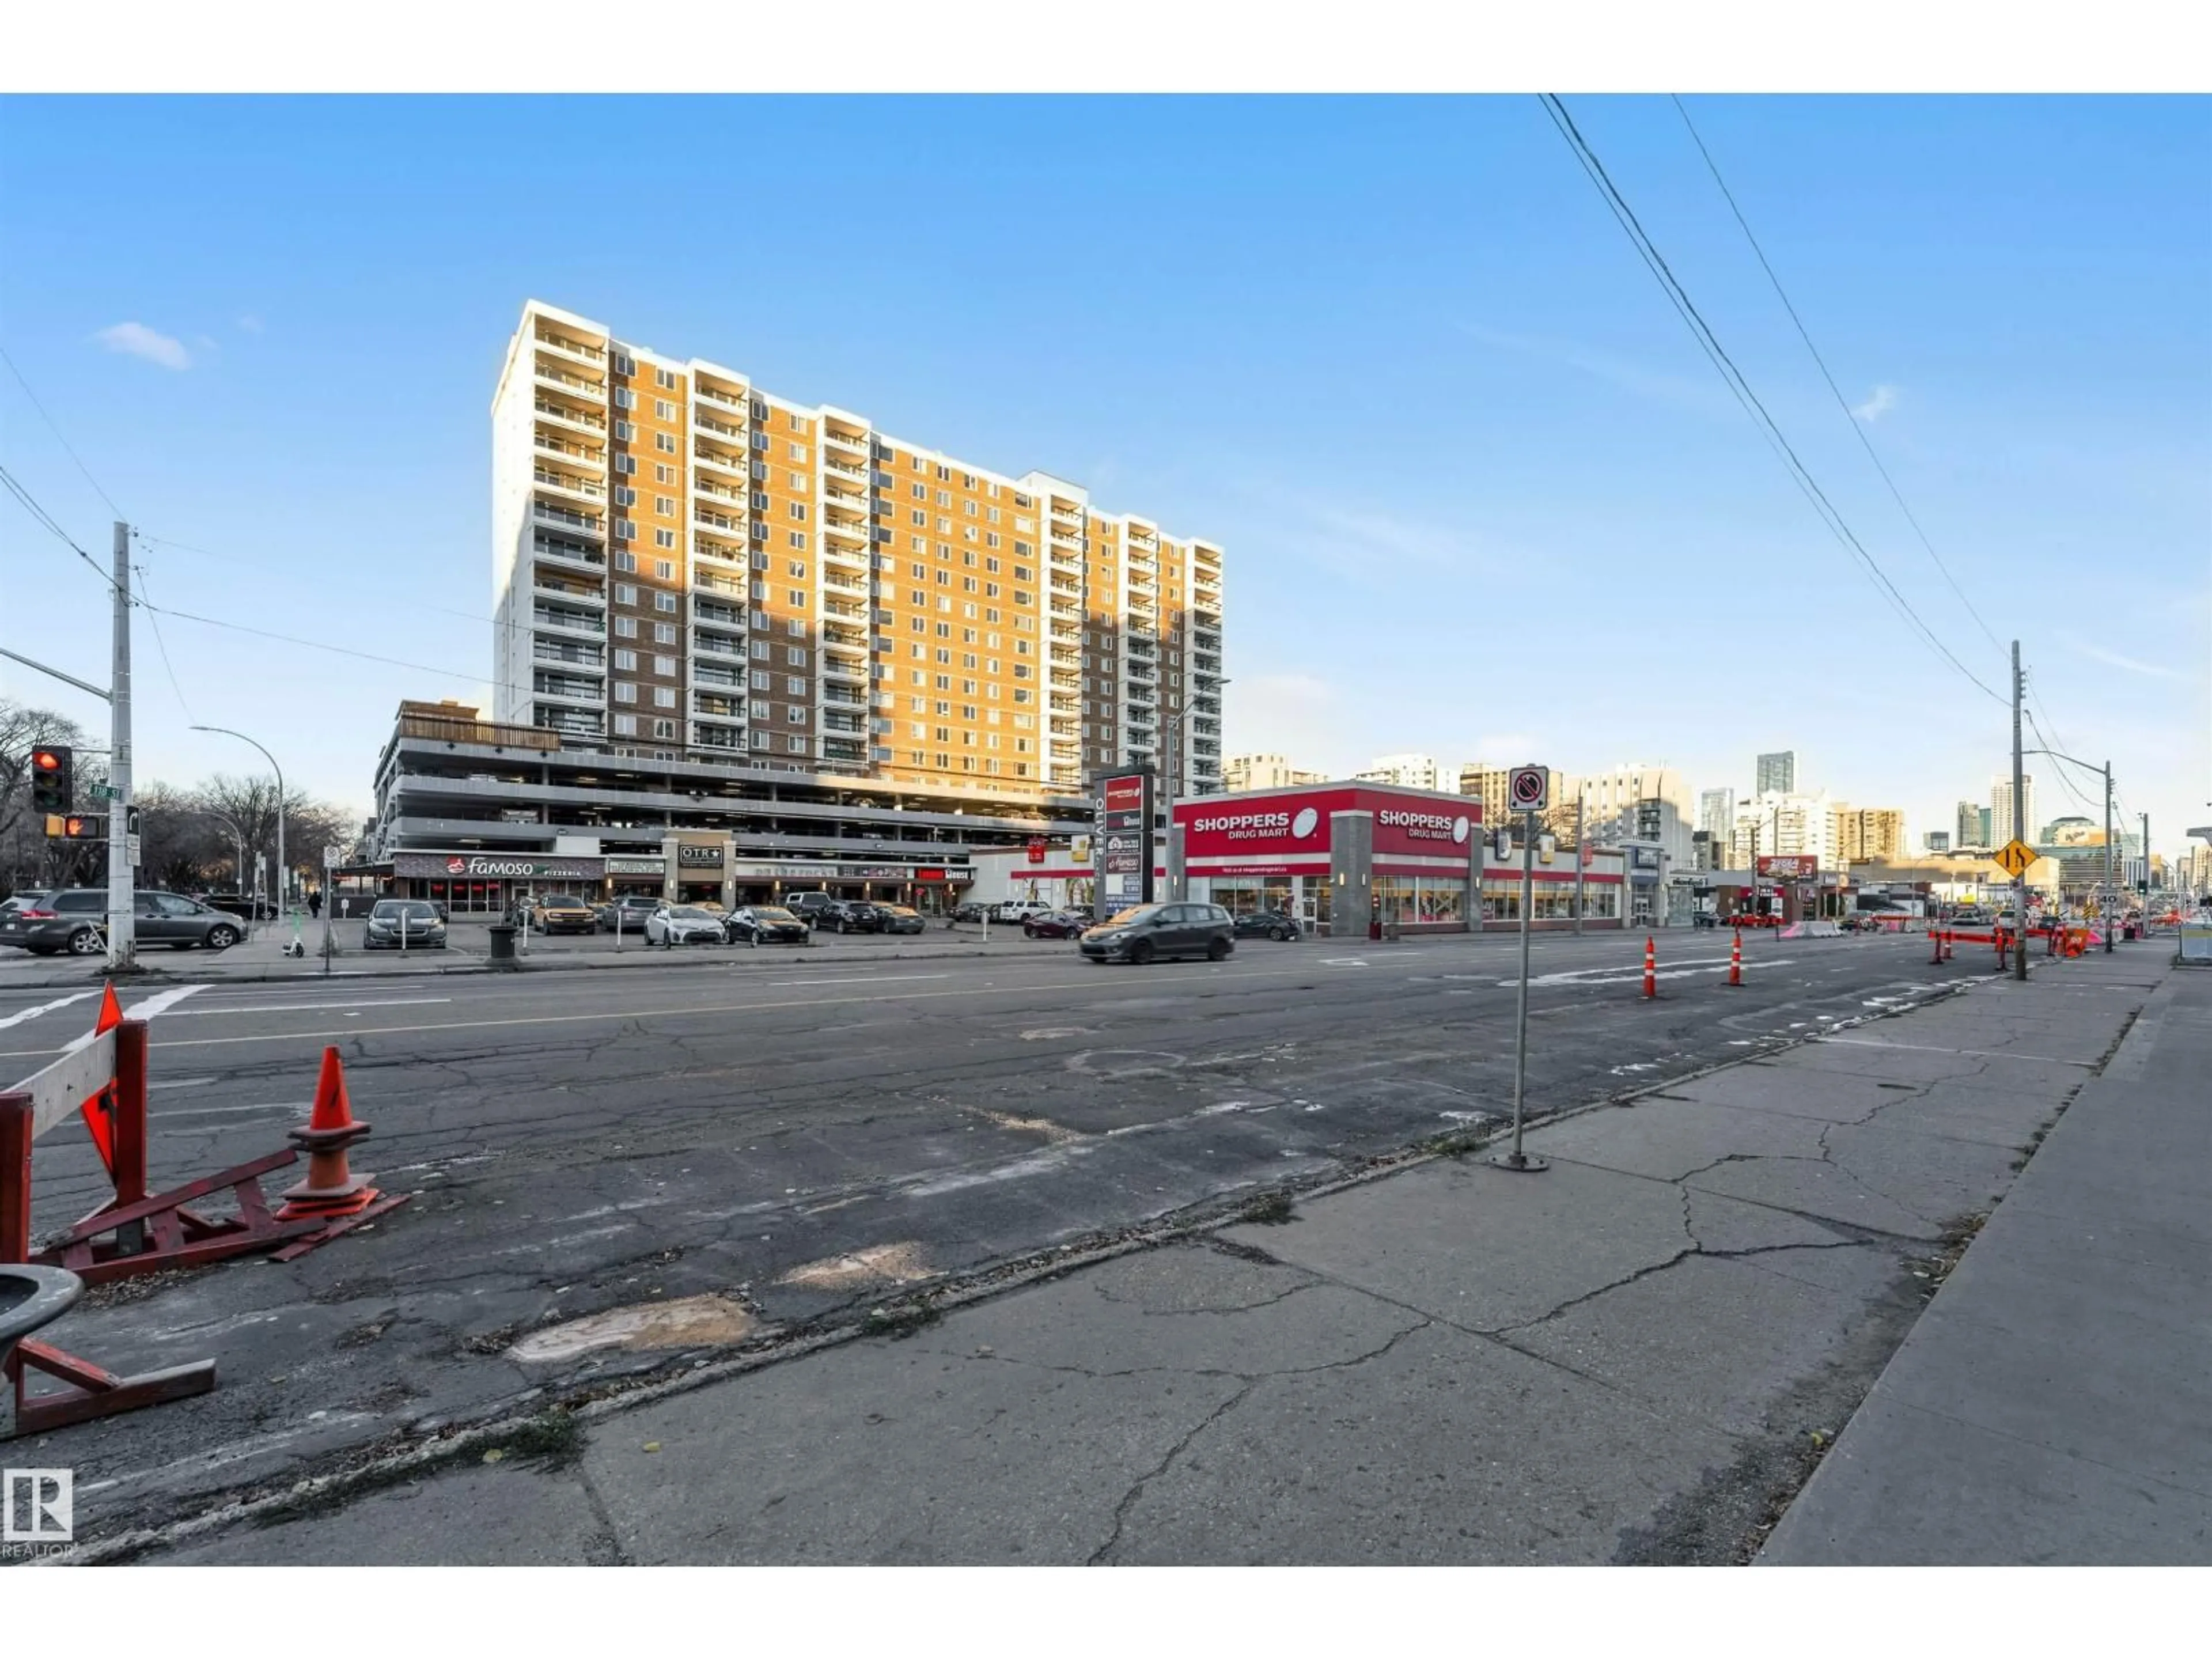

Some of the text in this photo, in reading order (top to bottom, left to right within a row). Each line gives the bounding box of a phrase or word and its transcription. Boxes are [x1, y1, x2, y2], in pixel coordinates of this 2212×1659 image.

[1095, 797, 1104, 855] OLIVER
[1194, 812, 1289, 832] SHOPPERS
[1380, 809, 1452, 830] SHOPPERS
[1228, 828, 1289, 839] DRUG MART
[1408, 828, 1452, 839] DRUG MART
[683, 849, 709, 858] OTR
